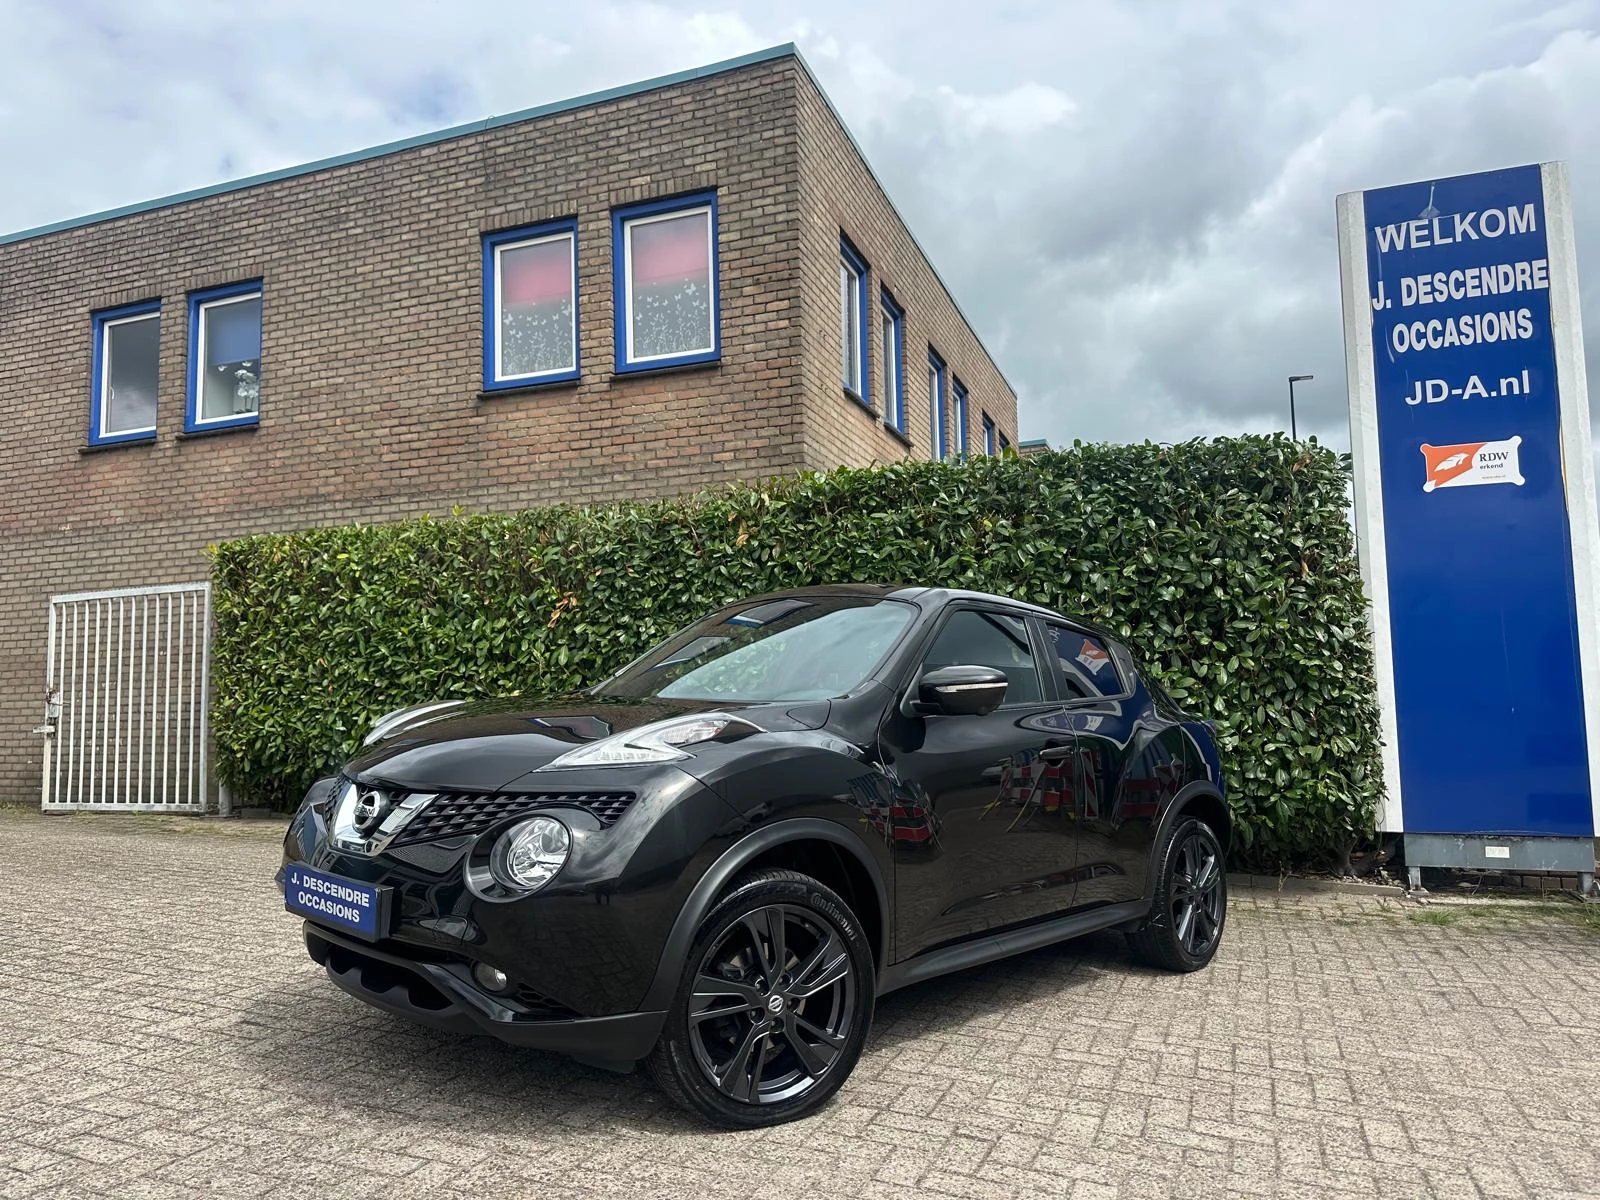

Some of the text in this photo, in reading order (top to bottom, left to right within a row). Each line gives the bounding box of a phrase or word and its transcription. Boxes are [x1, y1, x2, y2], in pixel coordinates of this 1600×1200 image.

[1374, 203, 1537, 254] WELKOM
[1371, 258, 1550, 311] J. DESCENDRE
[1392, 307, 1534, 353] OCCASIONS
[1404, 369, 1531, 406] JD-A.nl
[1479, 451, 1509, 462] RDW
[291, 872, 370, 908] J. DESCENDRE
[298, 891, 360, 923] OCCASIONS
